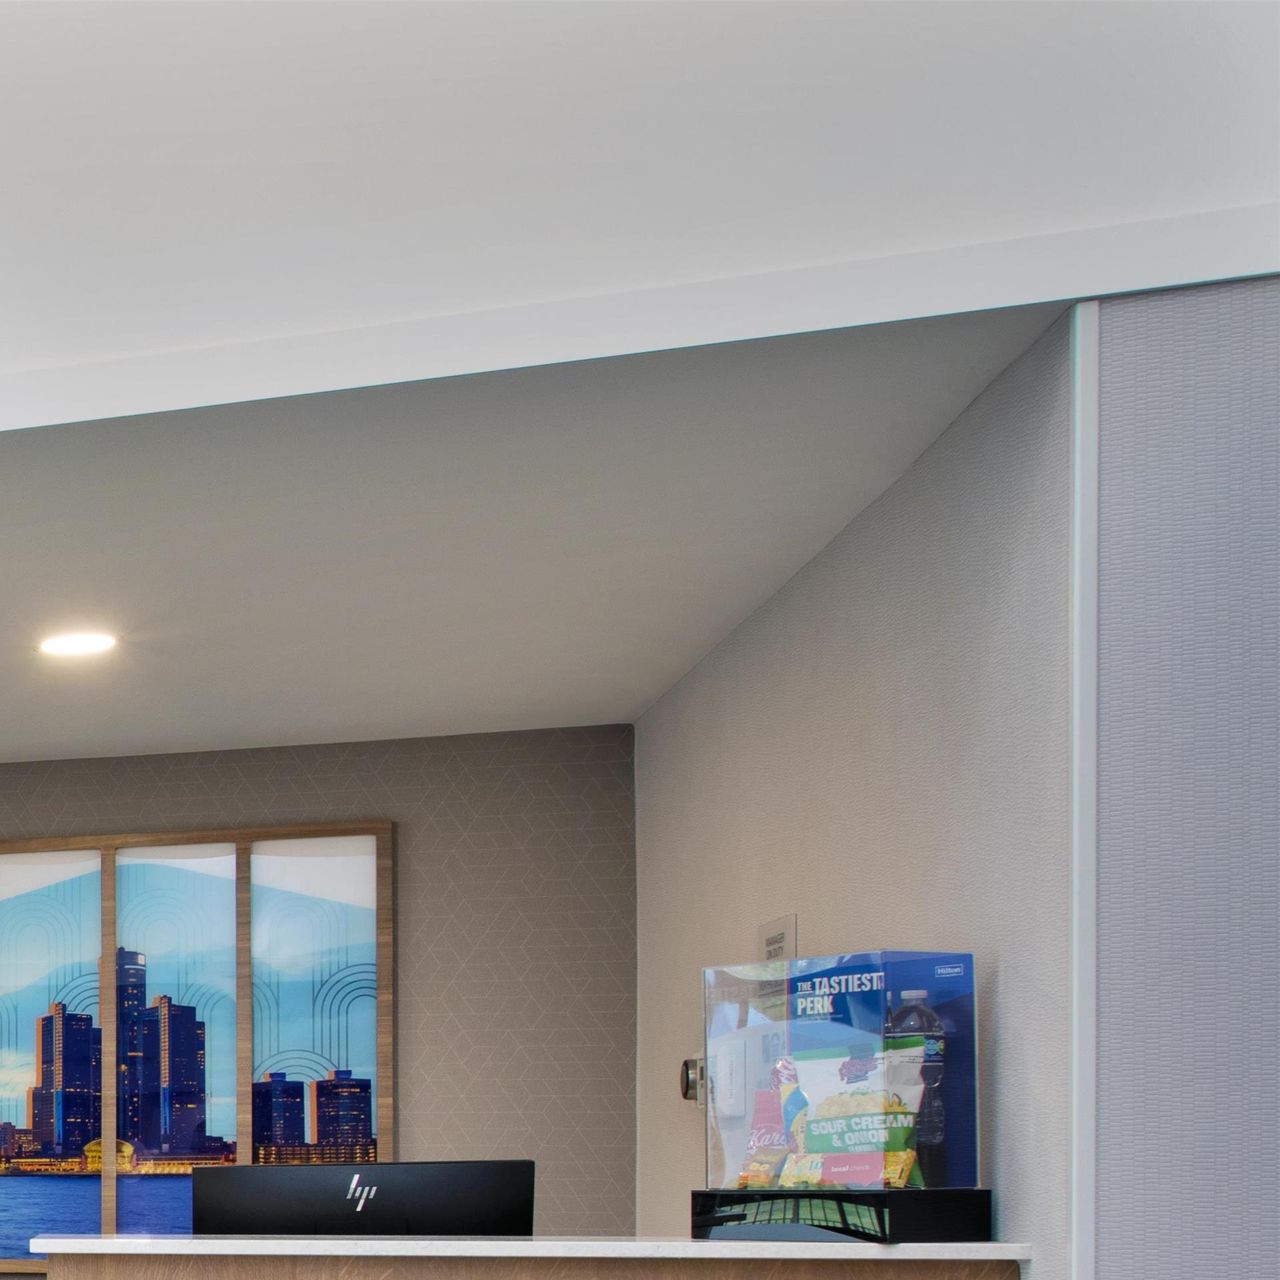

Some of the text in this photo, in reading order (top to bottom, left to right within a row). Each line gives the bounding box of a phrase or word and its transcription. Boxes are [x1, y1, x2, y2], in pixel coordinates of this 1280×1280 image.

[797, 972, 885, 996] THE TASTIEST
[796, 994, 835, 1016] PERK
[810, 1114, 914, 1136] SOUR CREAM
